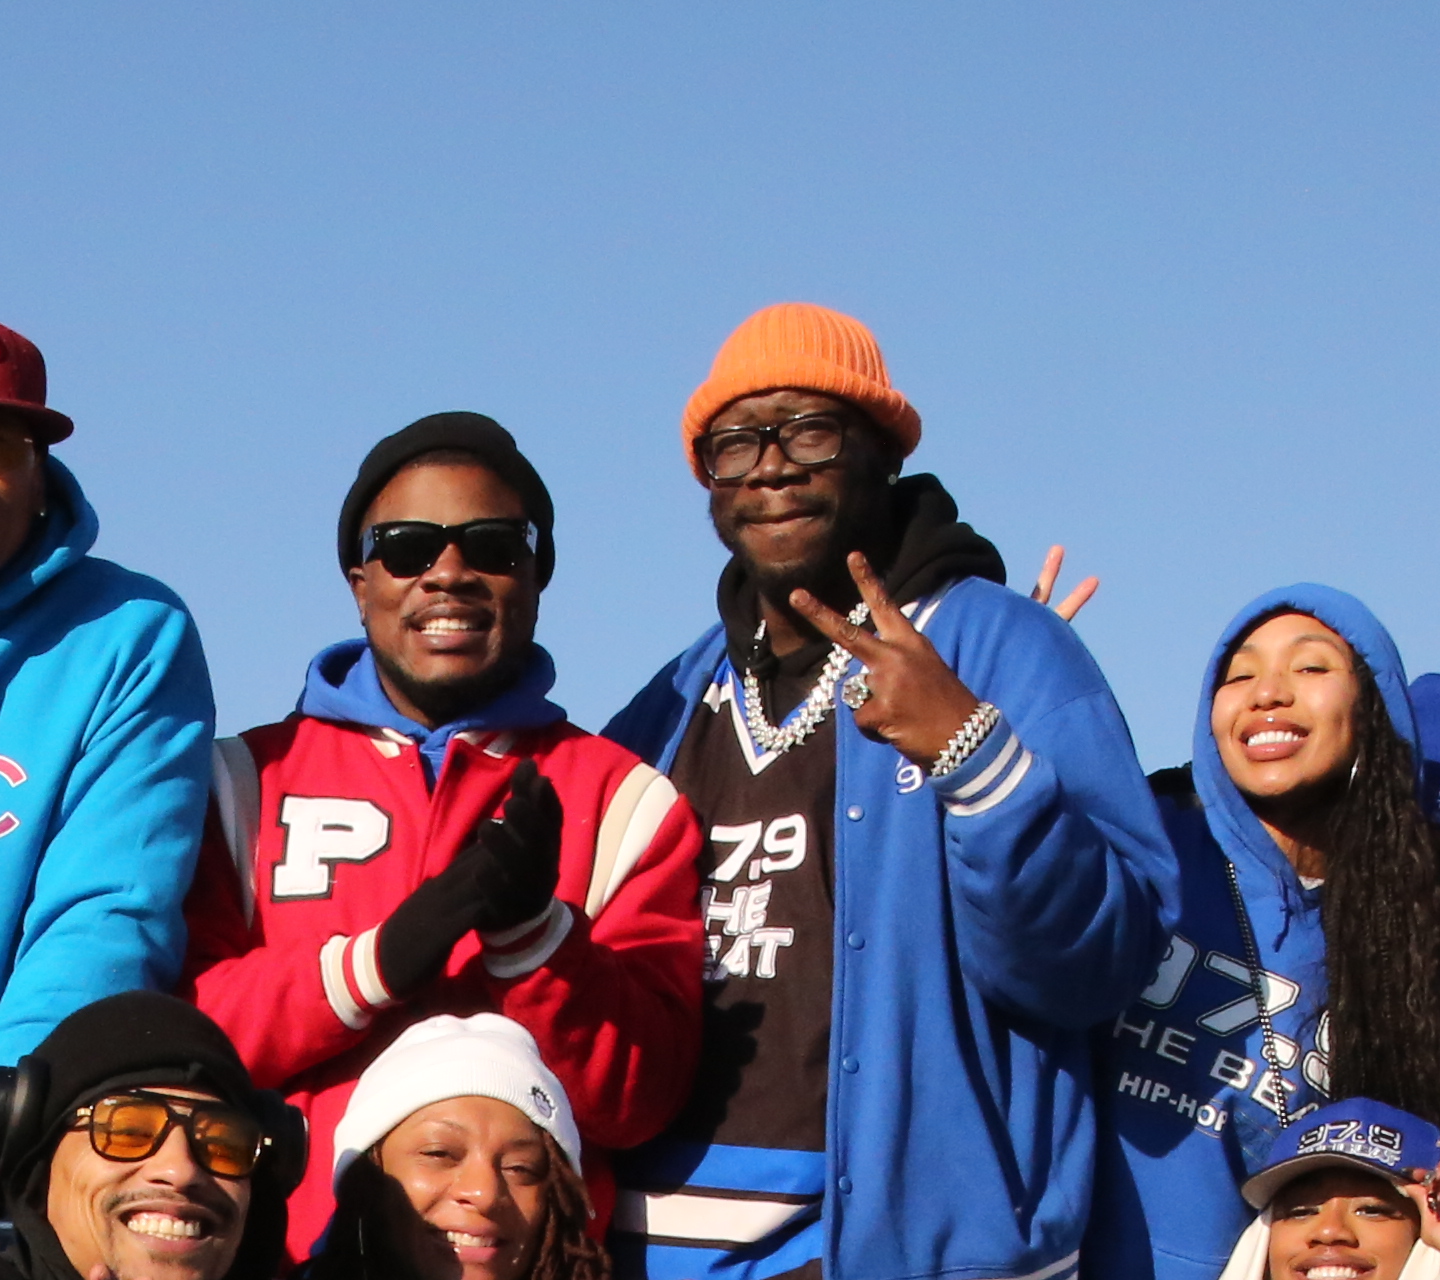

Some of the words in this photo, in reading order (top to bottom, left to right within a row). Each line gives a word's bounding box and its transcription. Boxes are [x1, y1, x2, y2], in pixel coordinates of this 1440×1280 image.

[273, 795, 390, 901] P
[708, 812, 807, 883] 7.9
[701, 878, 773, 937] HE
[1112, 1011, 1197, 1065] HE
